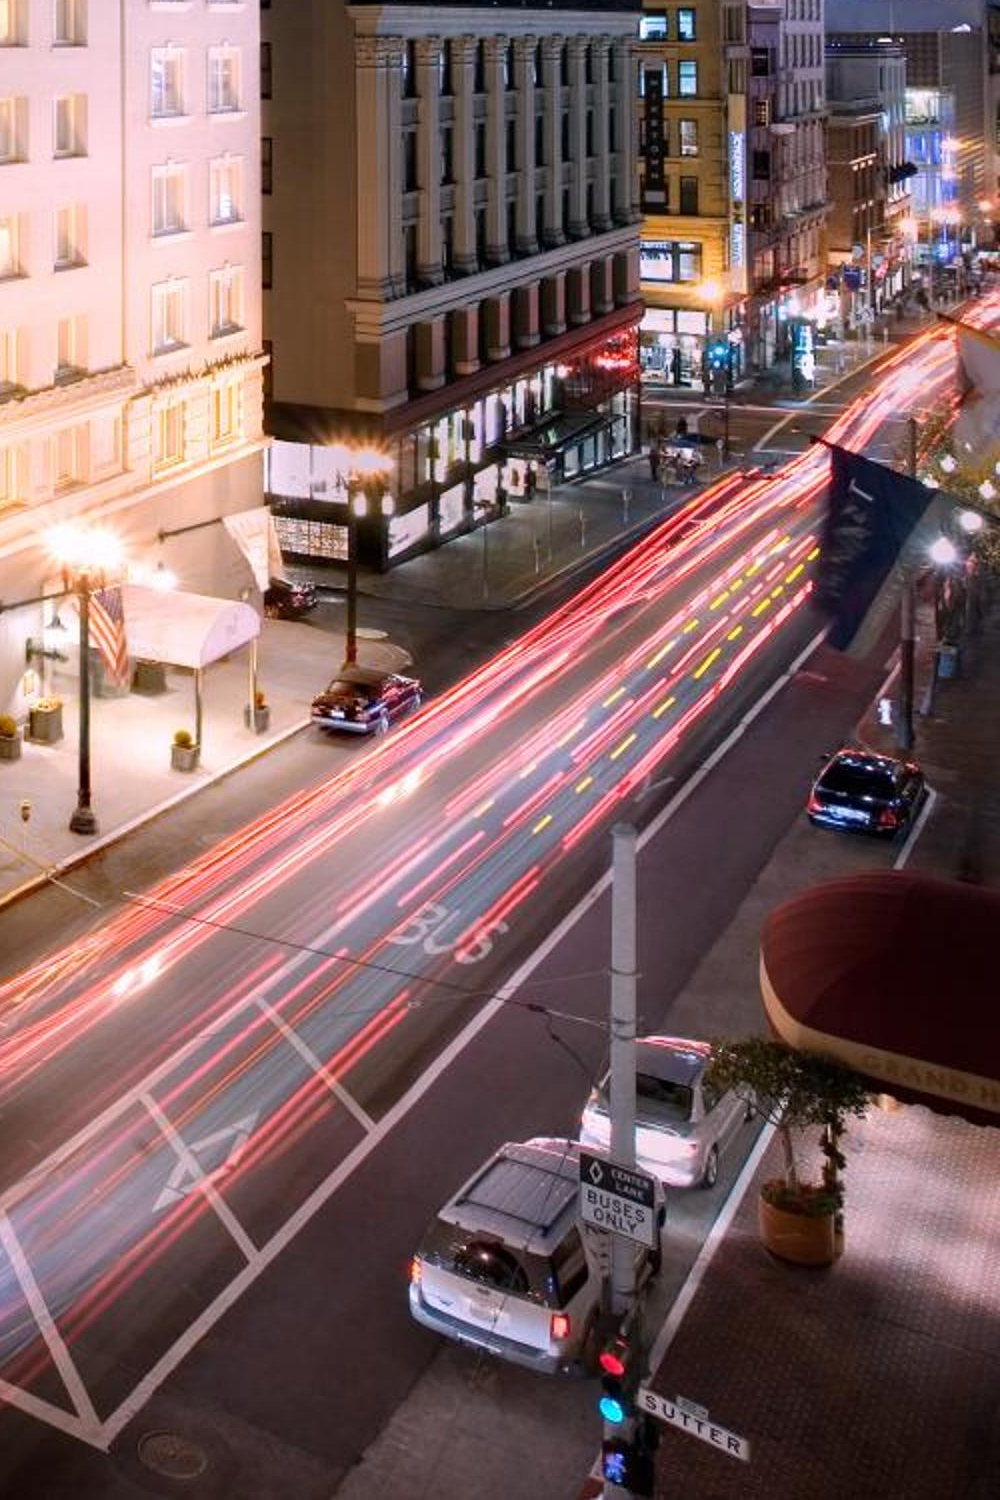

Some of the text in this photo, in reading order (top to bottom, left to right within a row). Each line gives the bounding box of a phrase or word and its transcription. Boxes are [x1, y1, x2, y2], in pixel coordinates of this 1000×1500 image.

[586, 1188, 646, 1223] BUSES
[593, 1206, 638, 1233] ONLY
[645, 1395, 741, 1453] SUTTER
